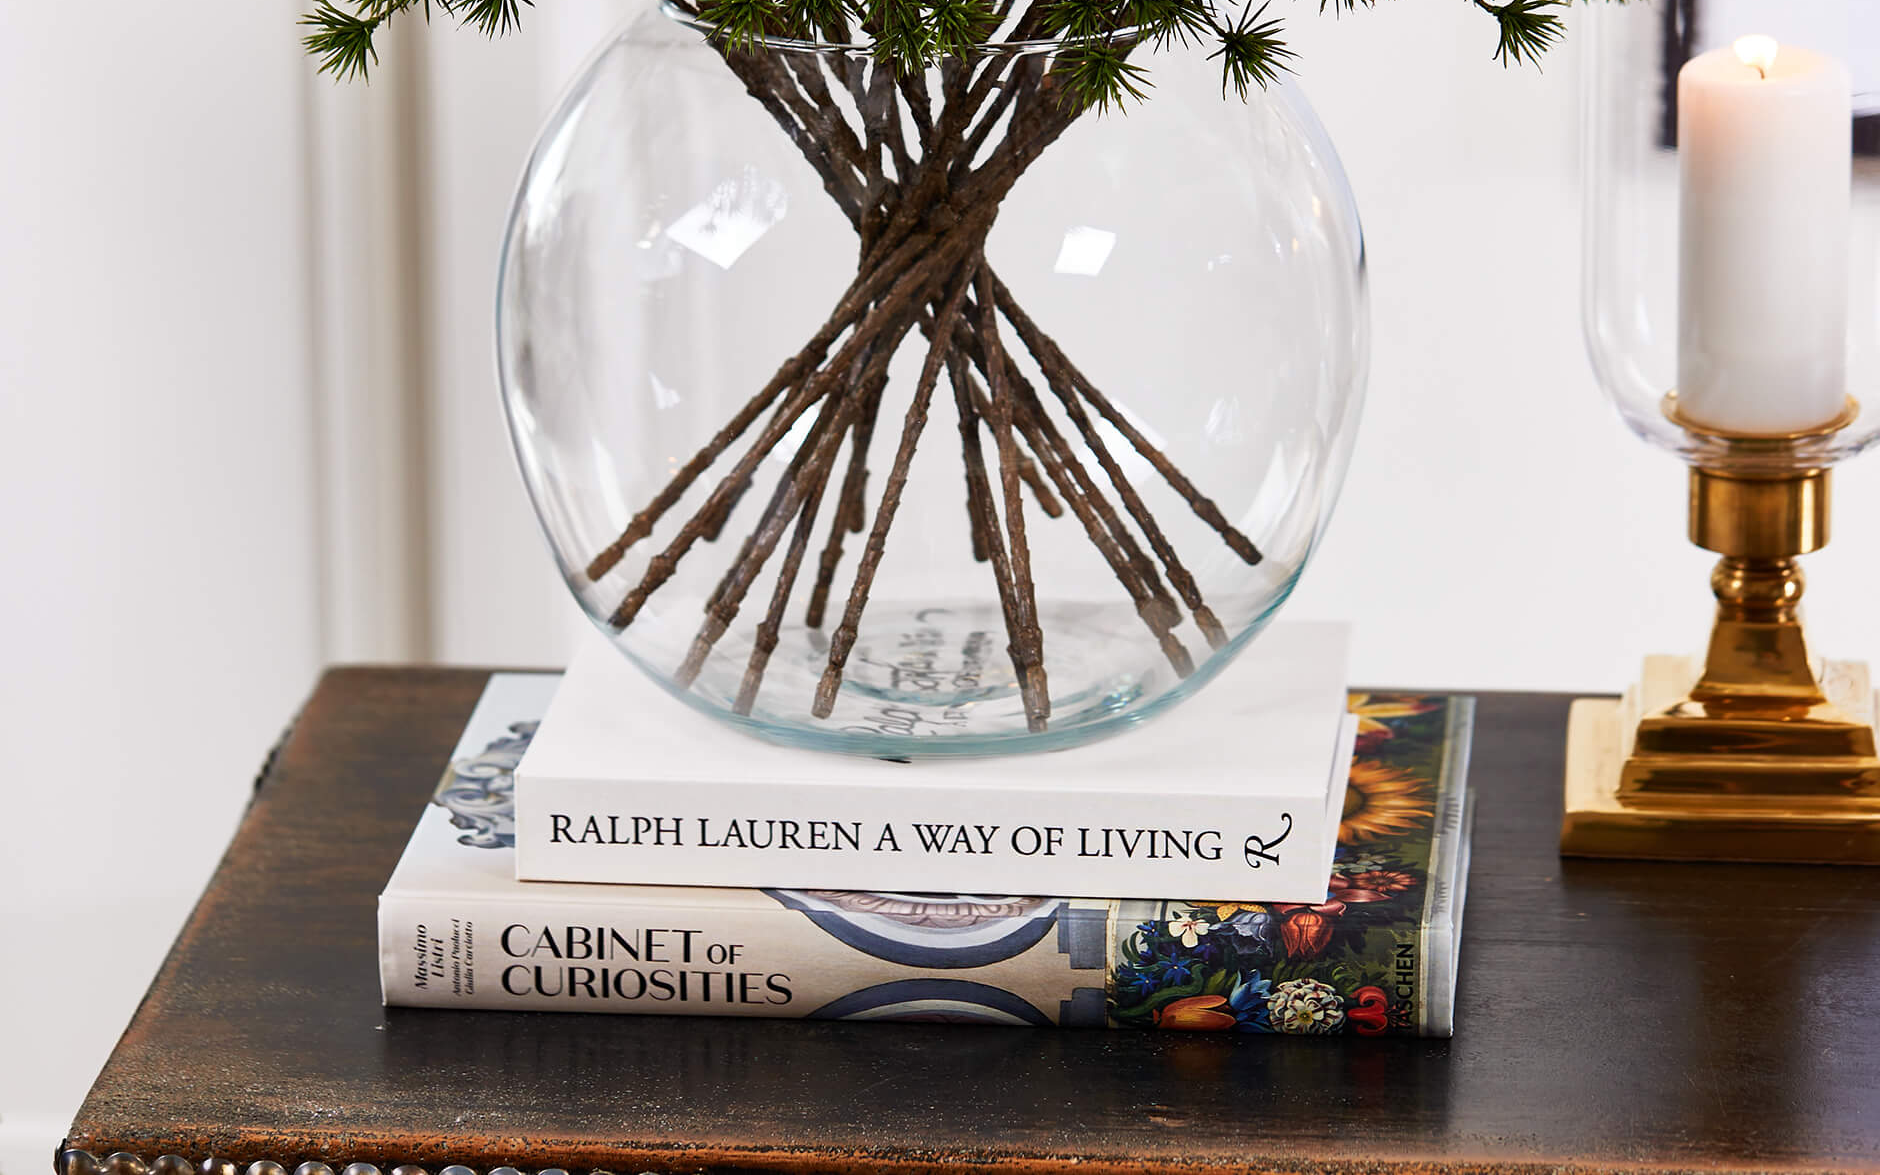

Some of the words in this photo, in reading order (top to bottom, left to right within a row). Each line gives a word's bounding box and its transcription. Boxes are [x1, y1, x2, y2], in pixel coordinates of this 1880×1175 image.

[550, 814, 684, 846] RALPH
[697, 817, 863, 851] LAUREN
[872, 822, 903, 852] A
[911, 823, 1001, 855] WAY
[1010, 826, 1064, 856] OF
[1077, 827, 1224, 861] LIVING
[414, 924, 428, 990] Massimo
[430, 937, 445, 977] Listri
[500, 924, 703, 964] CABINET
[706, 943, 745, 965] OF
[500, 965, 793, 1006] CURIOSITIES
[1395, 943, 1414, 1031] TASCHEN
